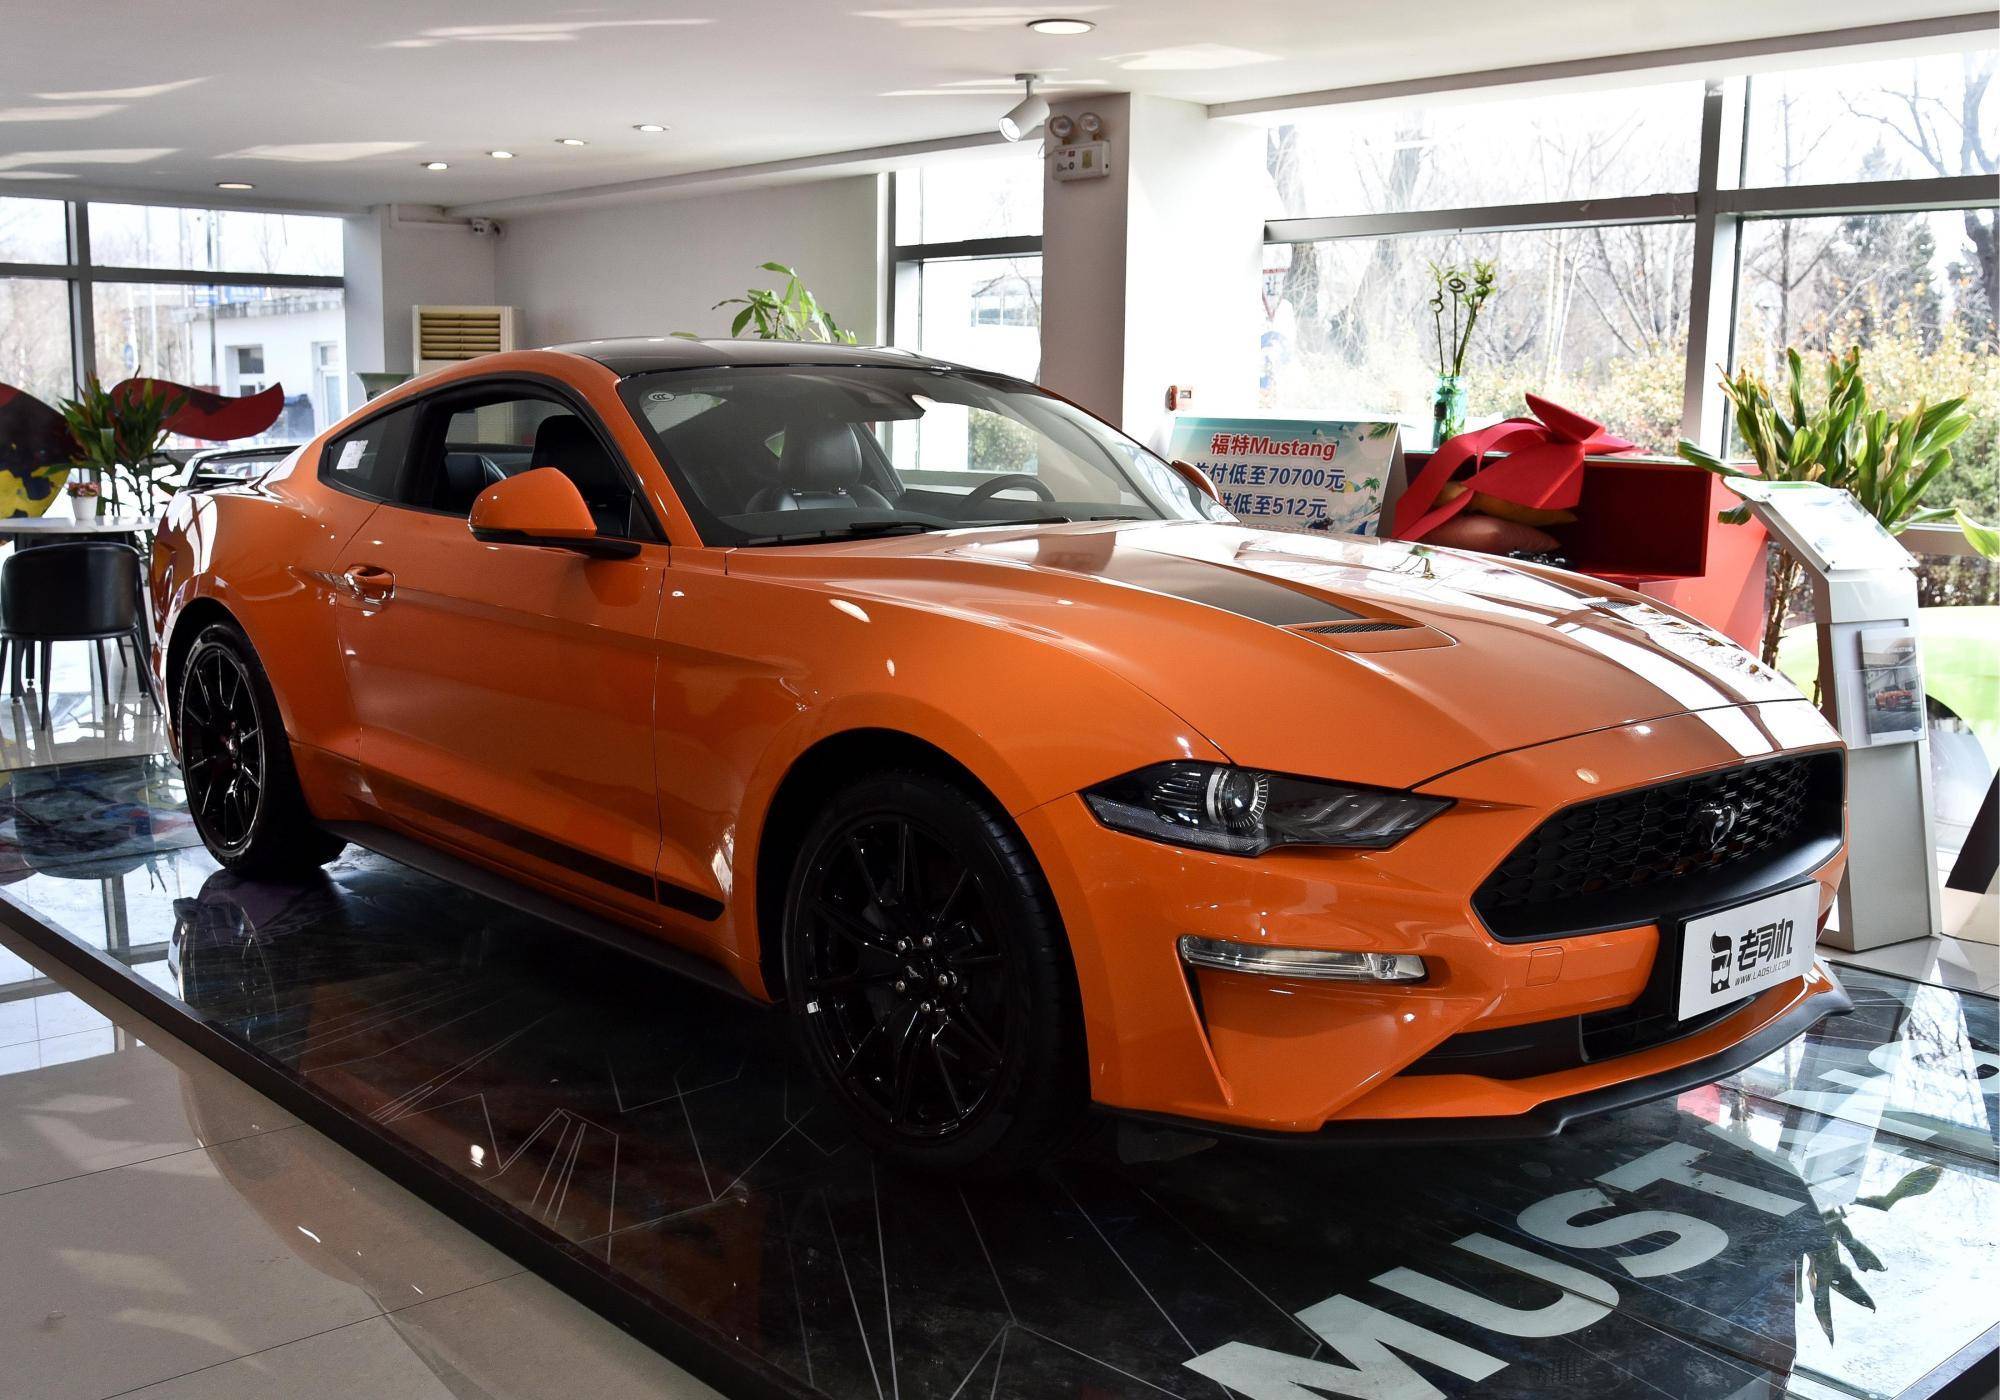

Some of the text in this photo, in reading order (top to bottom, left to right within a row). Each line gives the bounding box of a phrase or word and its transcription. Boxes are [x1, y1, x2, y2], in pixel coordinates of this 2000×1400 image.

[1211, 434, 1336, 460] 福特Mustang
[1738, 918, 1793, 971] 老司机
